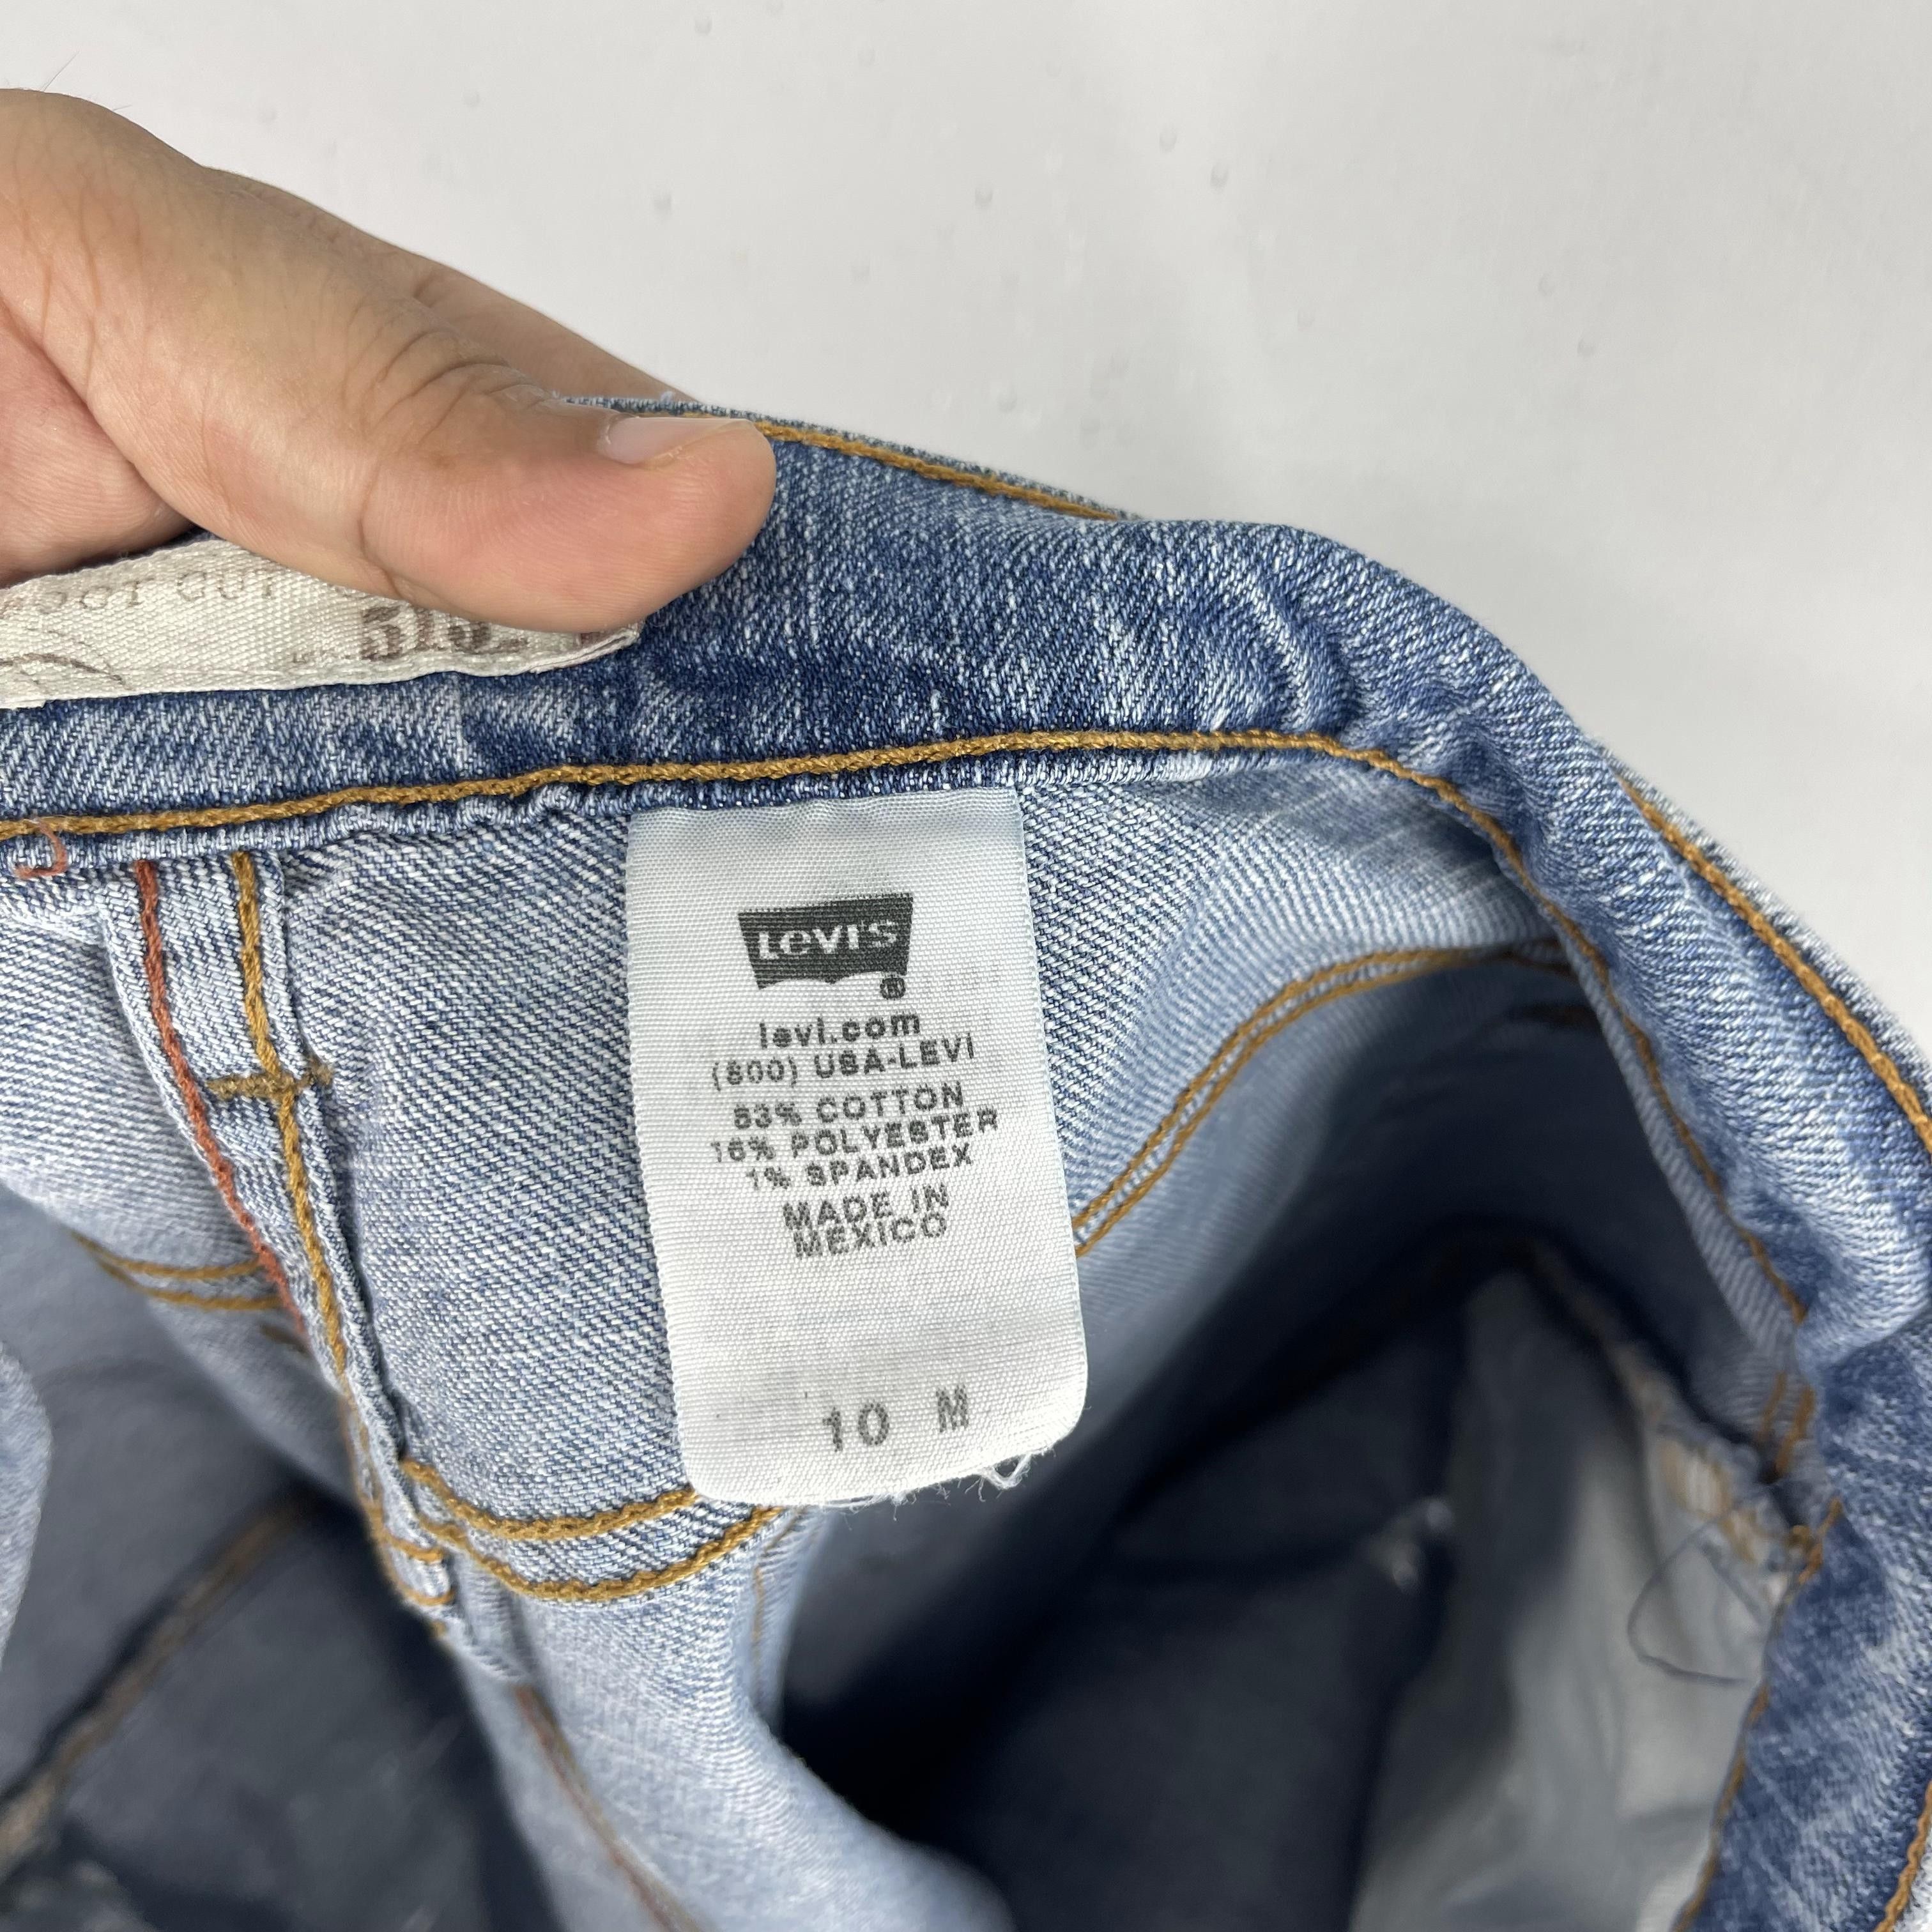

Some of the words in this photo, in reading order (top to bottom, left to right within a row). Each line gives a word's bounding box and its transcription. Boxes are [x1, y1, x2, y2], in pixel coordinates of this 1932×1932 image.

[760, 1011, 921, 1050] levi.com
[712, 1056, 799, 1091] (800)
[814, 1033, 976, 1079] USA-LEVI
[816, 1082, 963, 1124] COTTON
[710, 1136, 776, 1163] 16%
[791, 1105, 999, 1159] POLYESTER
[746, 1165, 792, 1190] 1%
[806, 1143, 972, 1186] SPANDEX
[782, 1192, 894, 1230] MADE
[911, 1182, 950, 1213] IN
[793, 1214, 947, 1259] MEXICO
[822, 1400, 890, 1452] 10
[935, 1383, 969, 1432] M
